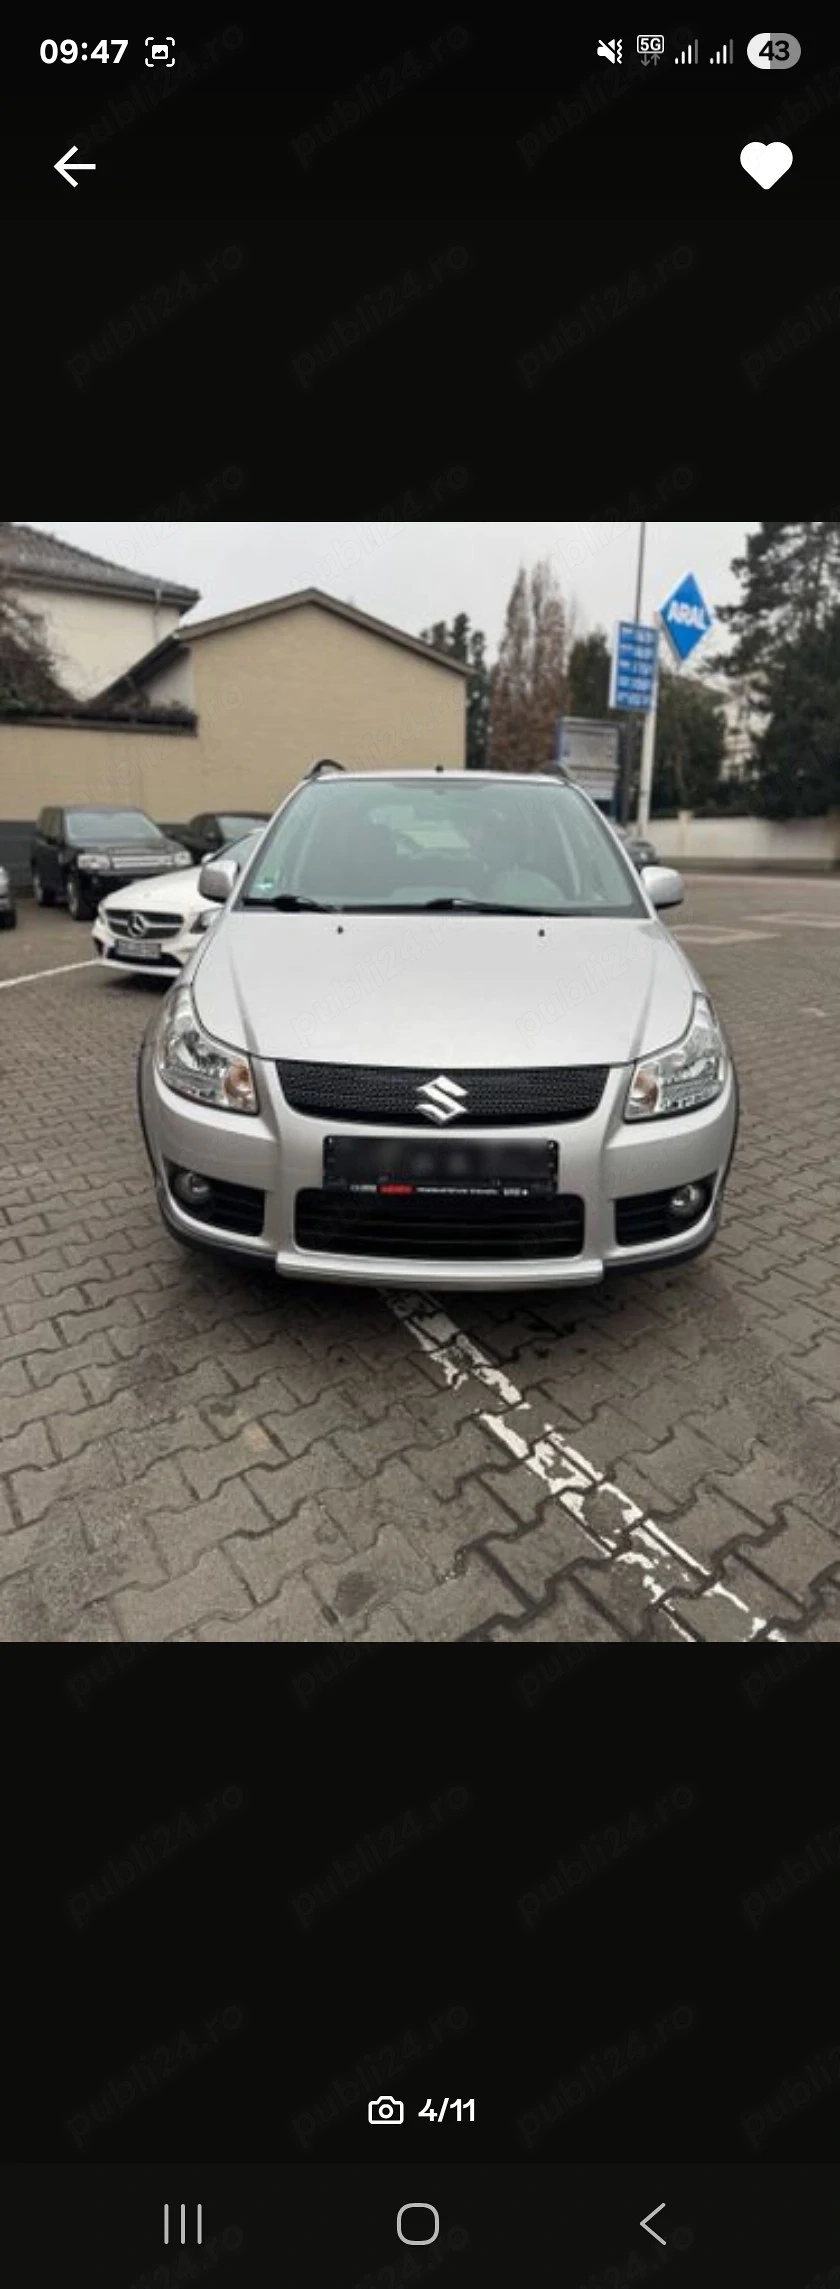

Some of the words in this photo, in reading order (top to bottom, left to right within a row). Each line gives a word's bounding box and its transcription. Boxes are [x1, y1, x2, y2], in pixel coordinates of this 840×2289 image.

[40, 39, 128, 65] 09:47
[640, 37, 662, 51] 5G
[759, 40, 790, 61] 43
[667, 600, 707, 630] ARAL
